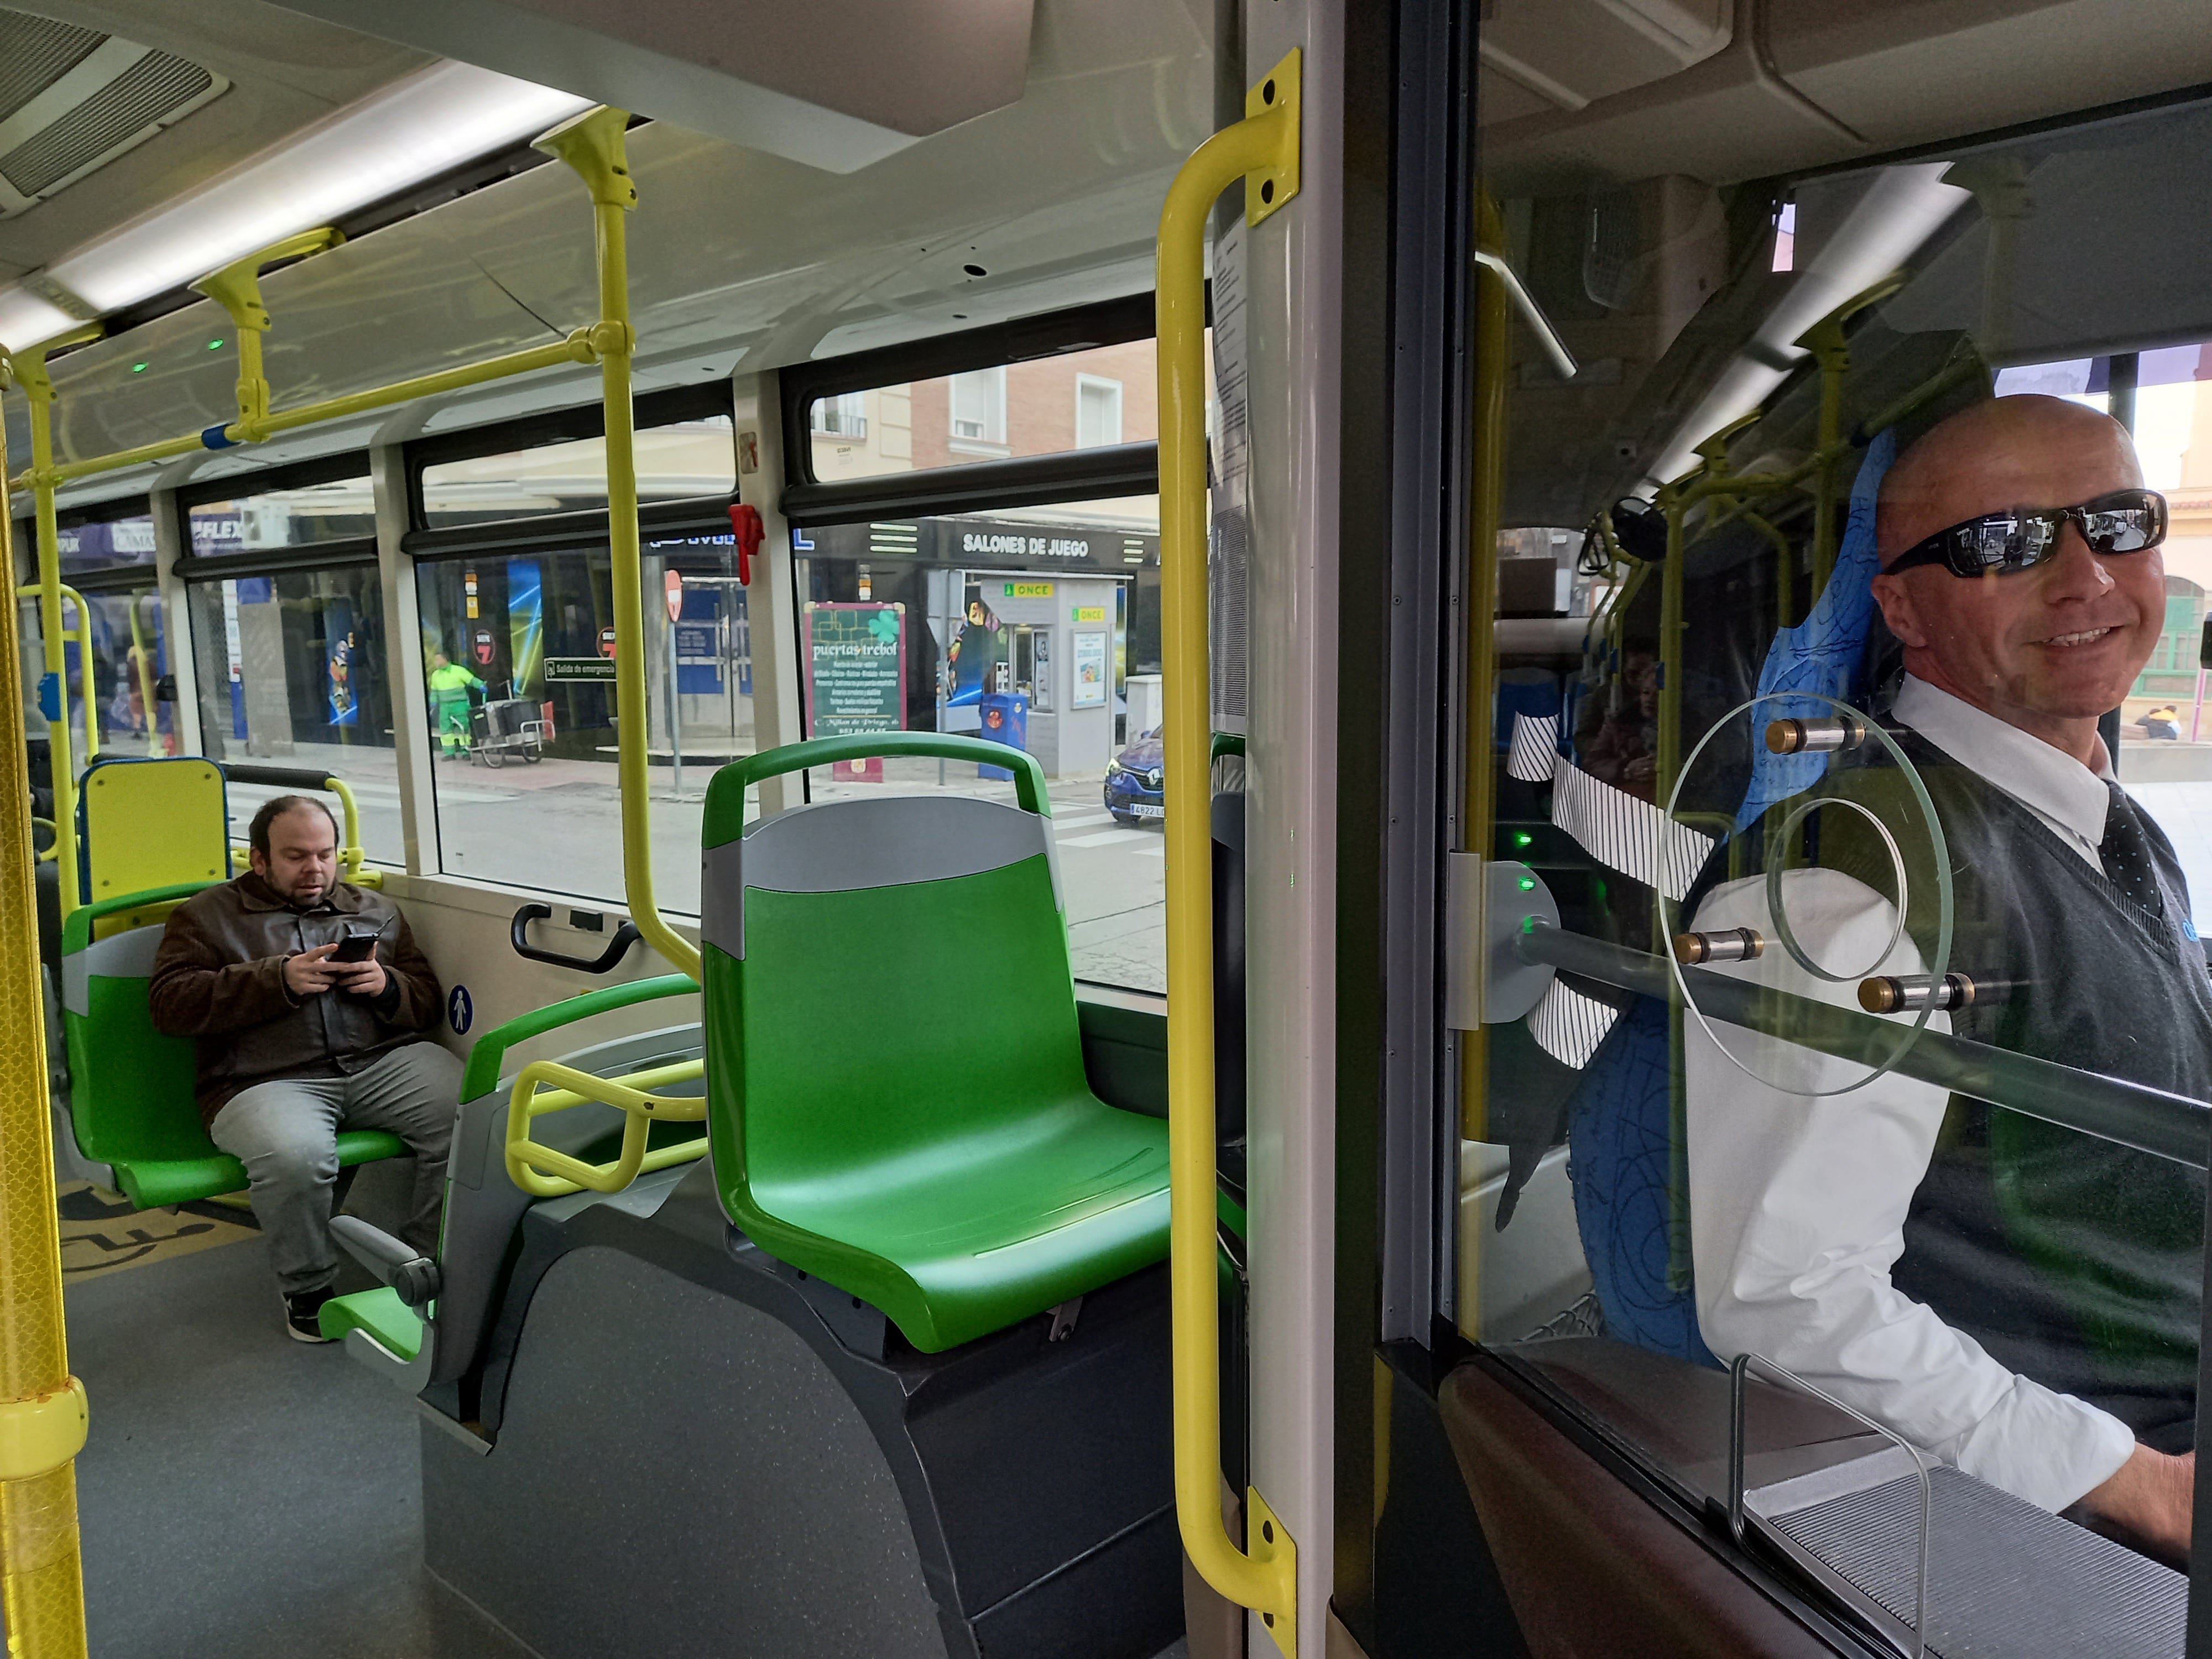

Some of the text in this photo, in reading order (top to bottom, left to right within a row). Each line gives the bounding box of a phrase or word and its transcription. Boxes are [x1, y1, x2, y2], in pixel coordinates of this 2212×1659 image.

[963, 533, 1088, 557] SALONES DE JUEGO
[1018, 585, 1048, 595] ONCE
[1081, 610, 1102, 619] ONCE
[812, 644, 859, 661] puertas
[556, 664, 573, 673] Salida
[574, 664, 582, 673] de
[1136, 806, 1154, 815] 4822
